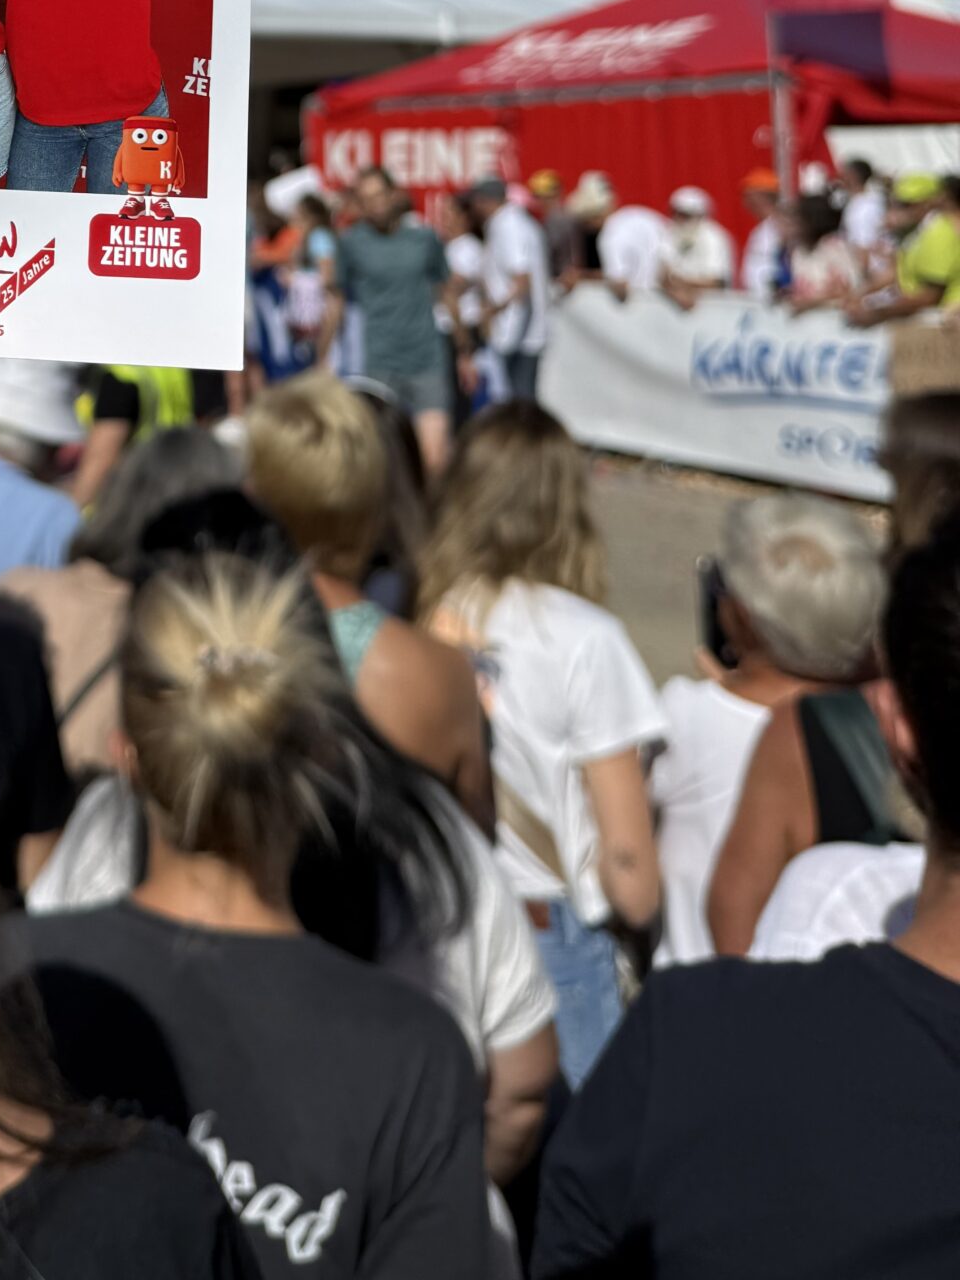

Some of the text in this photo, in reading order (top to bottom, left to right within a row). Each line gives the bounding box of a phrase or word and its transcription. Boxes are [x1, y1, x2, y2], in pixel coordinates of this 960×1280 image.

[160, 160, 172, 179] K
[109, 225, 182, 247] KLEINE
[100, 246, 188, 269] ZEITUNG
[1, 253, 51, 304] 25 Jahre
[693, 310, 888, 392] KÄRNTE
